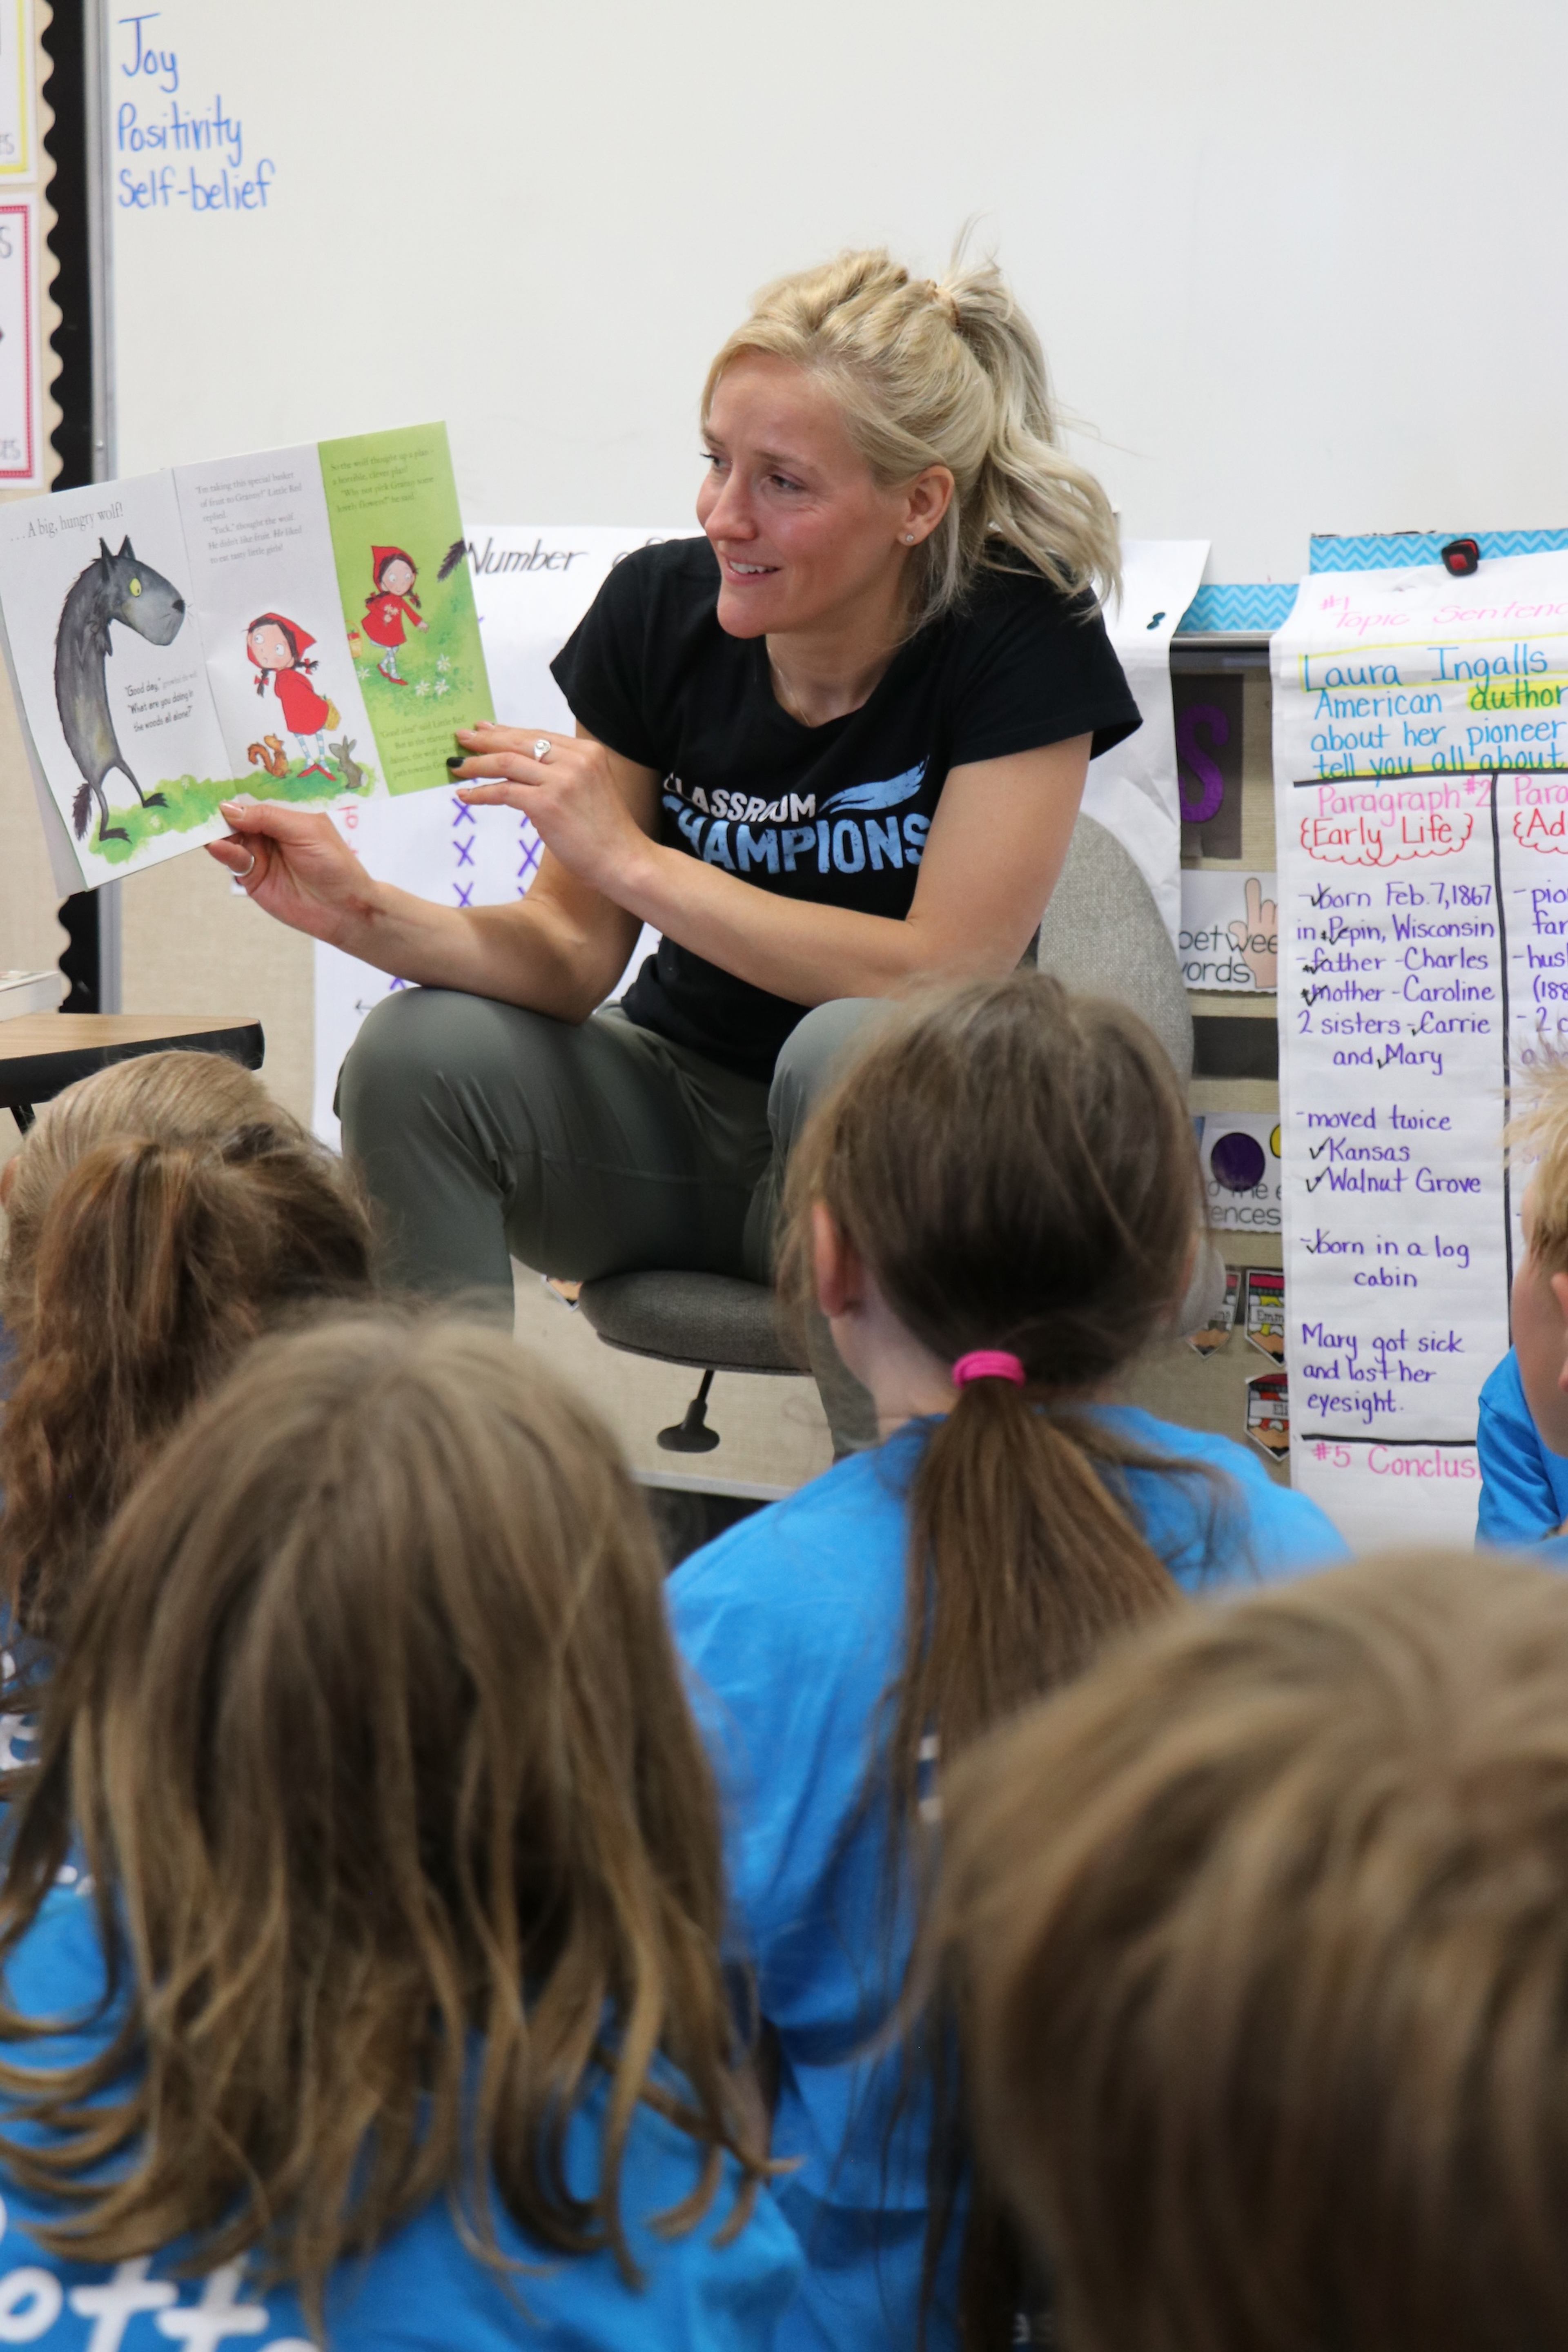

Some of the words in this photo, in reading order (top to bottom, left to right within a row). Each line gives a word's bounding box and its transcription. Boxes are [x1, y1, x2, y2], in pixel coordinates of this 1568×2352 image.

[118, 12, 179, 93] Joy
[119, 94, 242, 168] Positivity
[118, 158, 275, 211] Self-belief
[210, 481, 232, 493] taking
[233, 479, 246, 488] this
[248, 474, 271, 487] special
[272, 471, 294, 481] basket
[28, 521, 37, 538] A
[38, 519, 58, 538] big,
[59, 512, 94, 531] hungry
[97, 501, 124, 521] wolf!
[236, 518, 264, 531] thought
[468, 537, 589, 576] Number
[1335, 612, 1411, 636] Topic
[1304, 654, 1403, 692] Laura
[1427, 643, 1548, 693] Ingalls
[1314, 689, 1443, 720] American
[1470, 678, 1568, 711] author
[1310, 724, 1391, 752] about
[1404, 721, 1447, 746] her
[1466, 717, 1567, 756] pioneer
[1312, 753, 1355, 779] tell
[1370, 757, 1413, 788] you
[1431, 745, 1464, 771] all
[1480, 742, 1564, 769] about
[1319, 782, 1460, 827] Paragraph
[1463, 774, 1491, 808] #2
[1514, 774, 1568, 806] Para
[1297, 919, 1315, 940] in
[1329, 916, 1386, 947] Pepin,
[1392, 913, 1495, 942] Wisconsin
[1298, 1009, 1313, 1034] 2
[1321, 1012, 1401, 1036] sisters
[1333, 1046, 1374, 1065] and
[1385, 1042, 1443, 1076] Mary
[1388, 1104, 1452, 1130] twice
[1329, 1133, 1410, 1162] Kansas
[1327, 1167, 1408, 1193] Walnut
[1415, 1167, 1481, 1193] Grove
[1377, 1234, 1399, 1256] in
[1407, 1243, 1429, 1256] a
[1435, 1234, 1470, 1268] log
[1354, 1267, 1418, 1287] cabin
[1302, 1323, 1358, 1361] Mary
[1372, 1329, 1409, 1364] got
[1418, 1330, 1466, 1353] sick
[1303, 1360, 1339, 1379] and
[1348, 1358, 1397, 1382] lost
[1398, 1360, 1437, 1382] her
[1307, 1389, 1405, 1425] eyesight.
[1312, 1441, 1352, 1468] #5
